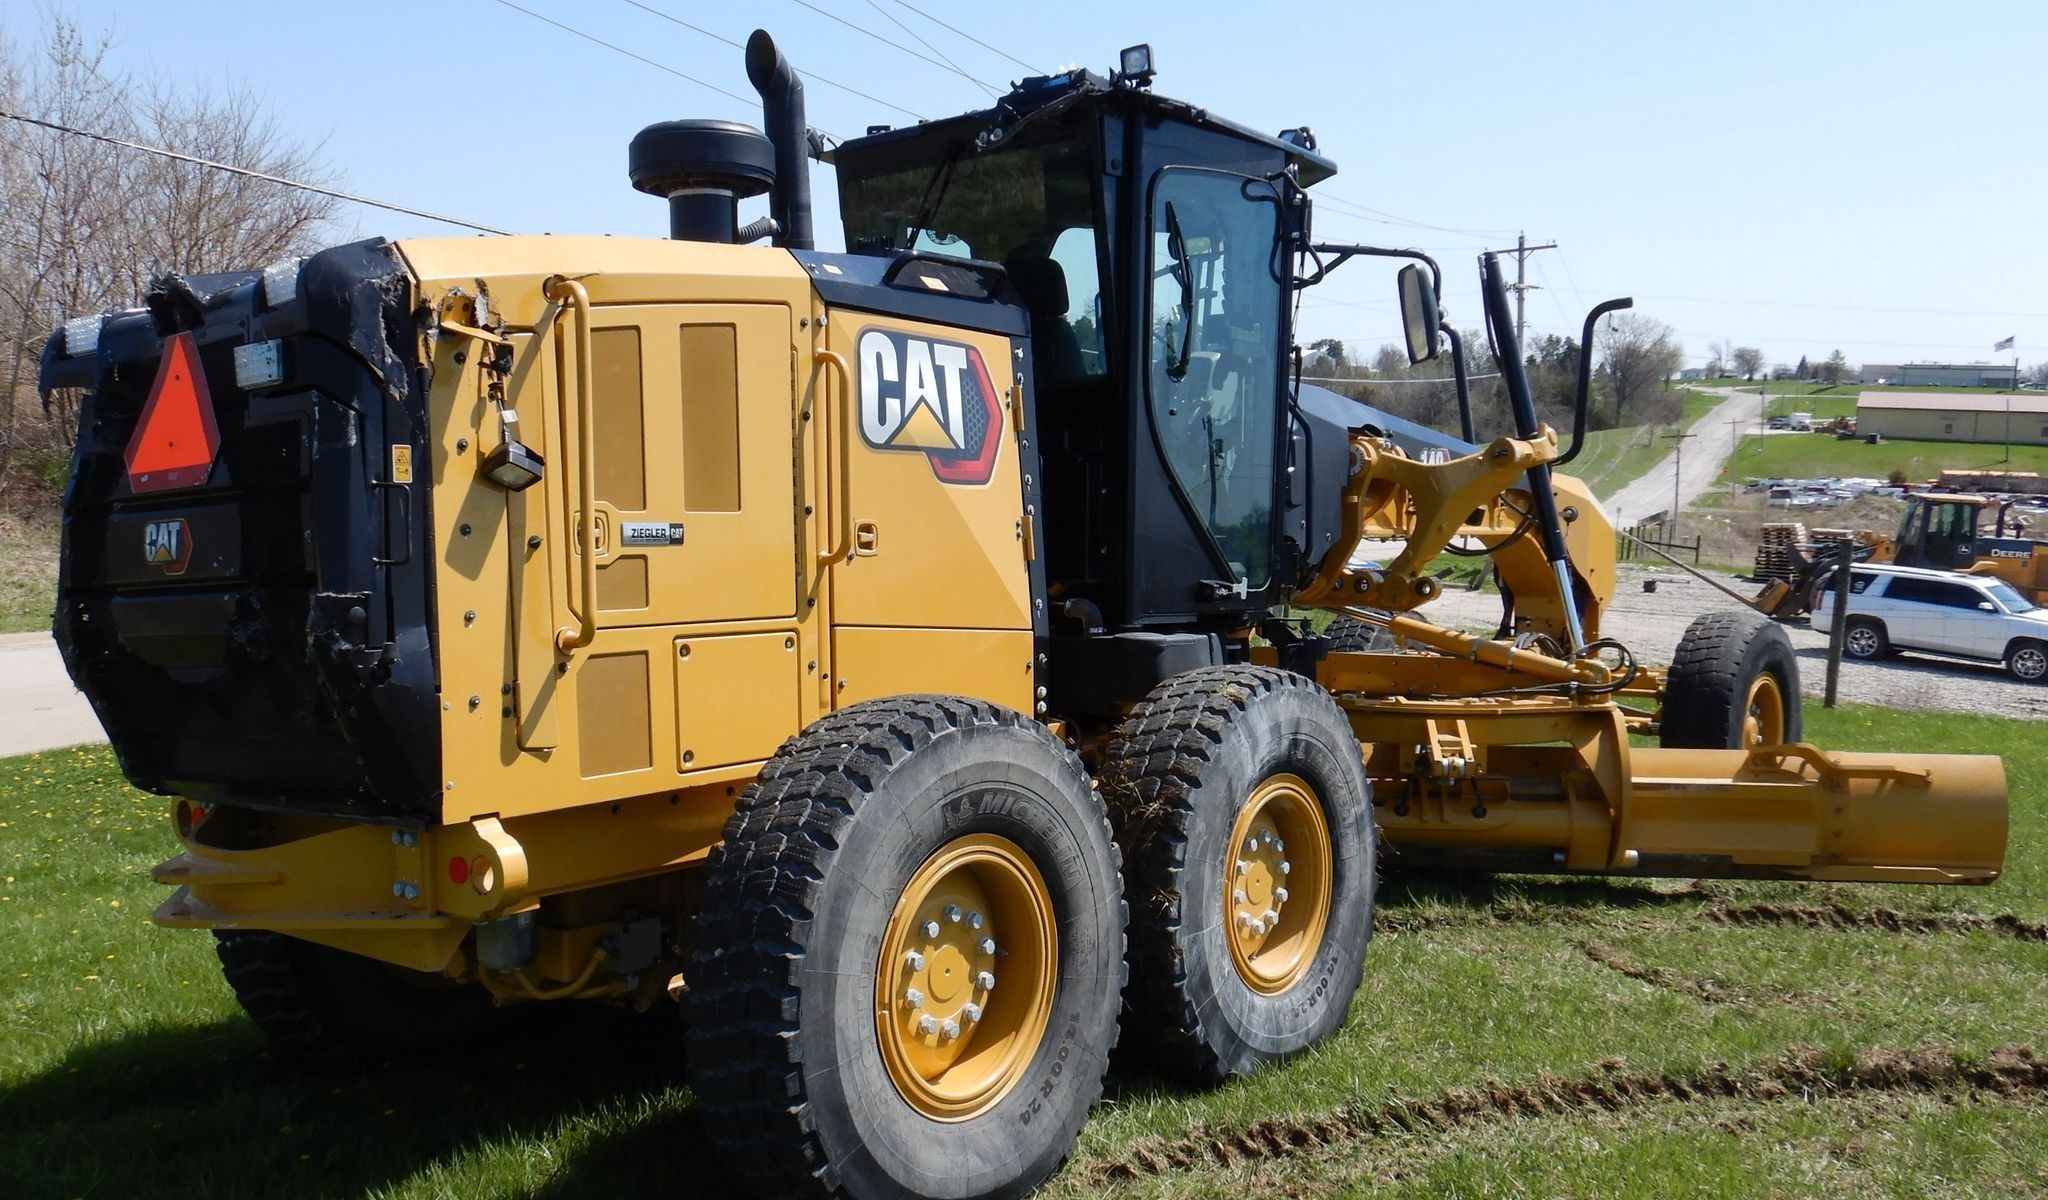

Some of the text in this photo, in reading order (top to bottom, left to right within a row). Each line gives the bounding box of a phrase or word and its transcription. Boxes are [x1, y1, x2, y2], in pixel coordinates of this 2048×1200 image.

[860, 331, 968, 449] CAT
[145, 521, 181, 562] CAT
[631, 527, 683, 539] ZIEGLER CAT
[1991, 549, 2031, 558] DEERE
[978, 792, 1083, 881] MICHELIN
